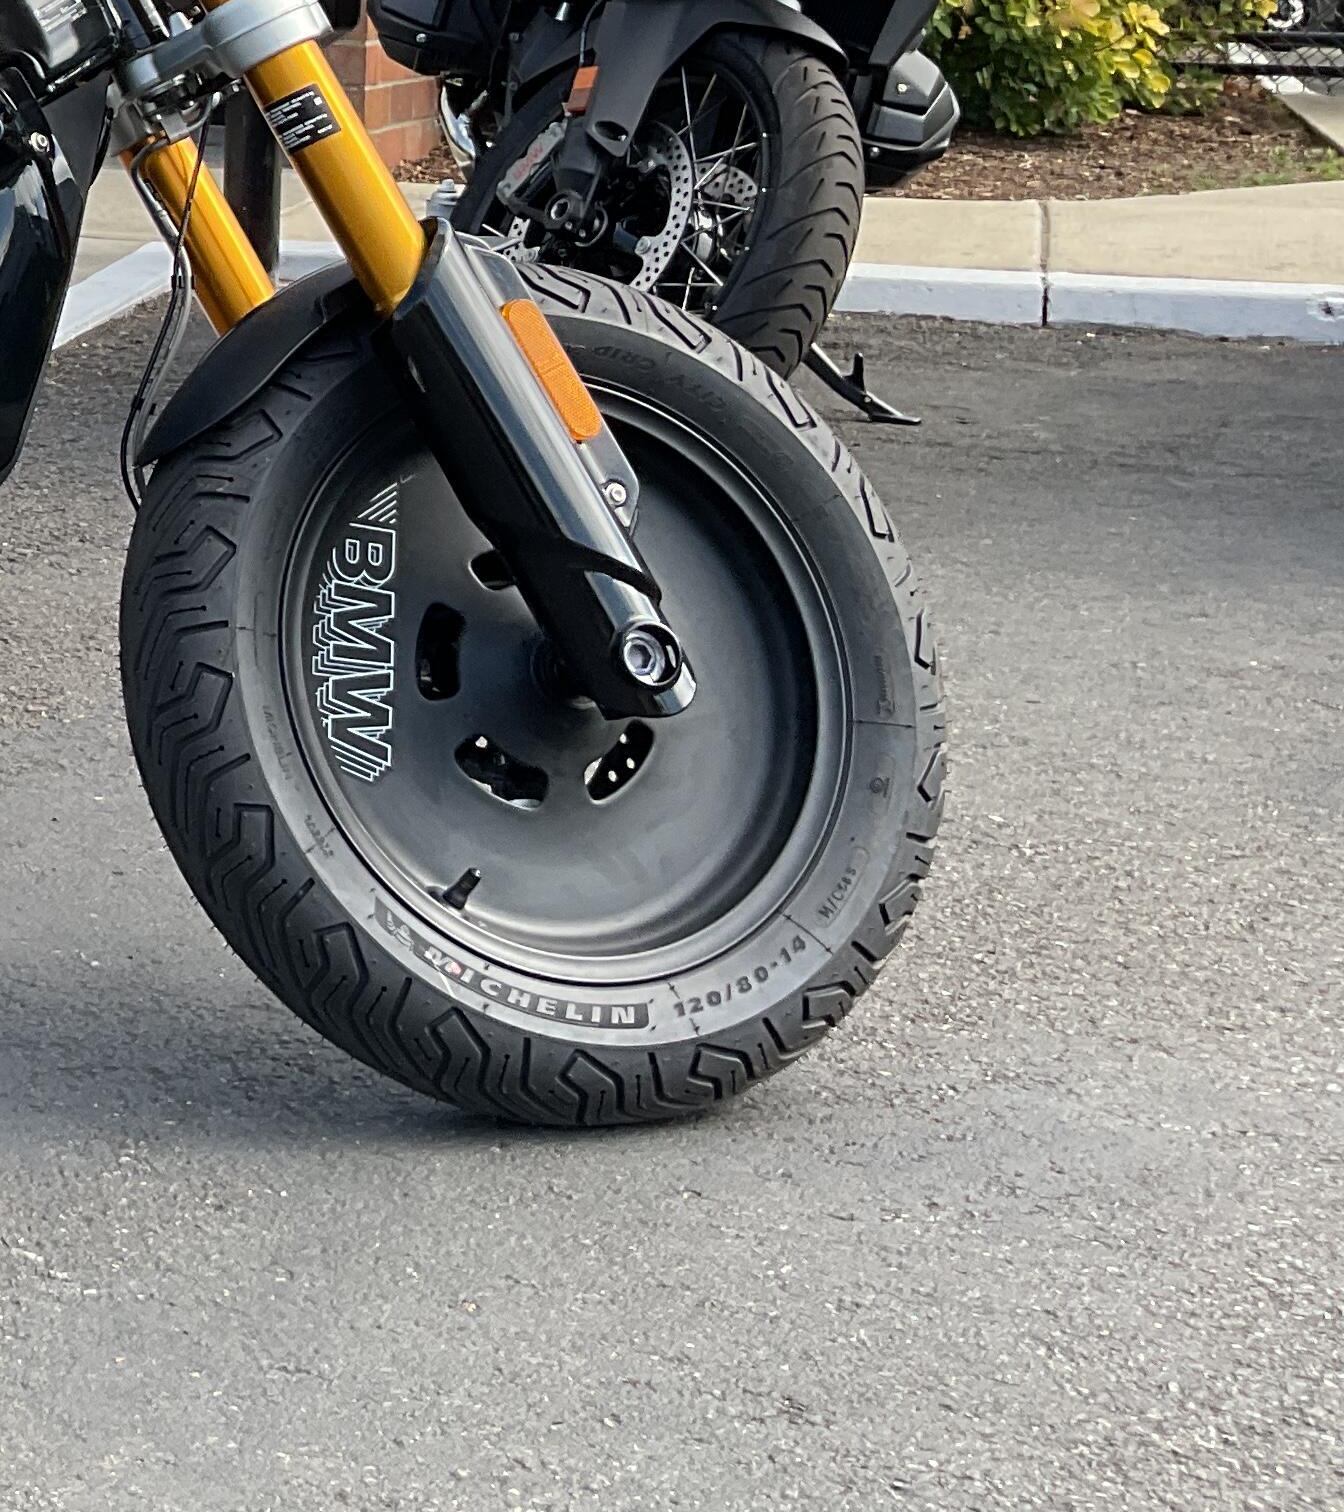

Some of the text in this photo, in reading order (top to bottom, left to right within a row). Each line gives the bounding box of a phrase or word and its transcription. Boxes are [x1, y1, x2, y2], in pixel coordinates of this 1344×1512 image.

[313, 522, 397, 782] BMW
[424, 945, 636, 1026] MICHELIN
[673, 934, 808, 1018] 120/80-14
